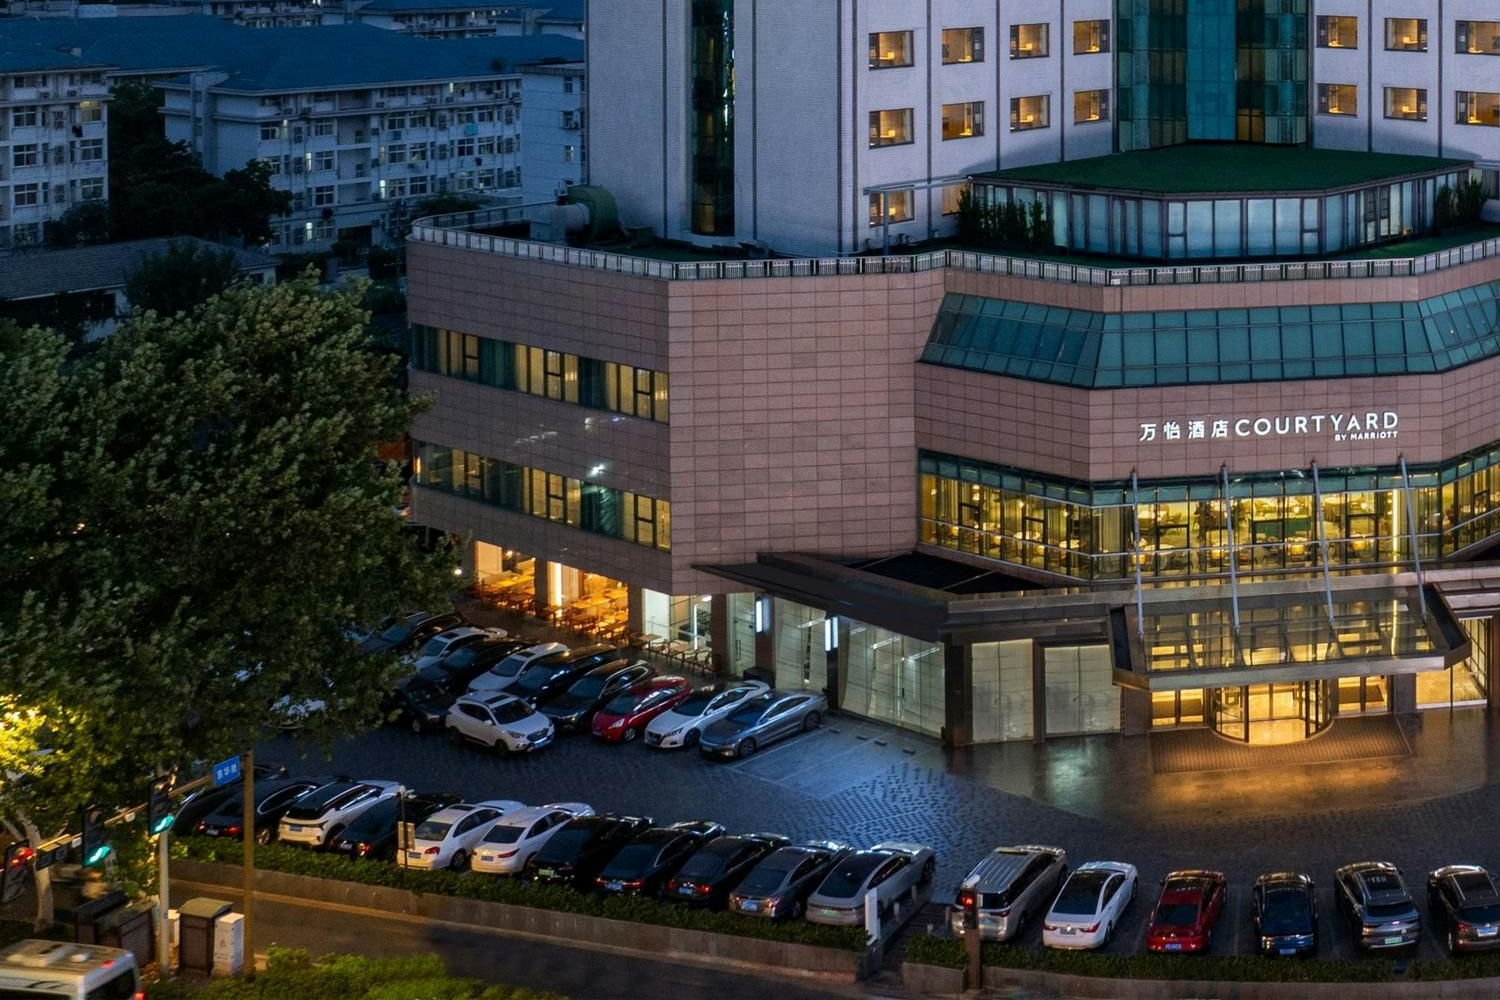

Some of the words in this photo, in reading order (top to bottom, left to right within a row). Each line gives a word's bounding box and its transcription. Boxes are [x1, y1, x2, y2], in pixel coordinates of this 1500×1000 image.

[1139, 419, 1229, 442] 万怡酒店
[1235, 412, 1399, 437] COURTYARD
[1335, 433, 1347, 442] BY
[1350, 431, 1399, 441] MARRIOTT
